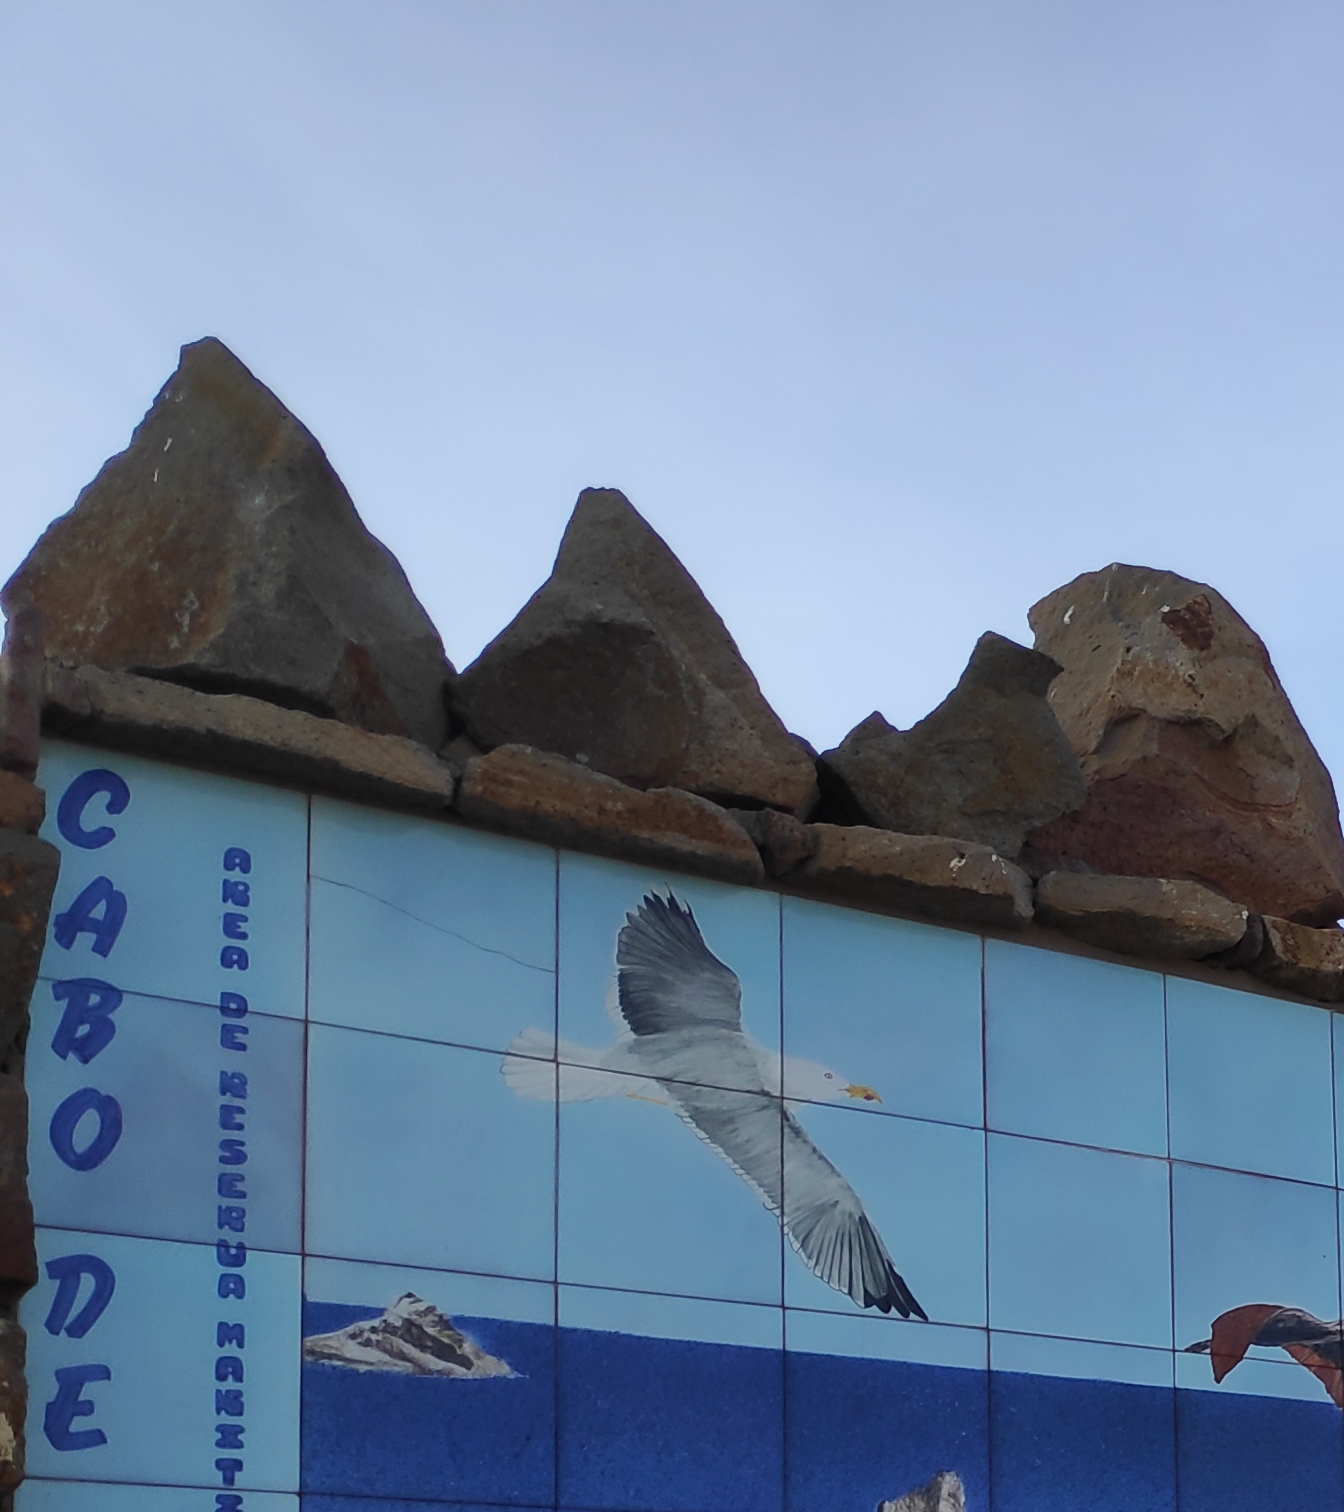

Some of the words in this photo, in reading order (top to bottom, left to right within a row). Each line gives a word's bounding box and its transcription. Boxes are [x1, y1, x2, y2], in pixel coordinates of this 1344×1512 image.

[49, 768, 131, 1171] CABO
[220, 847, 251, 971] AREA
[219, 991, 248, 1052] DE
[43, 1253, 116, 1451] DE
